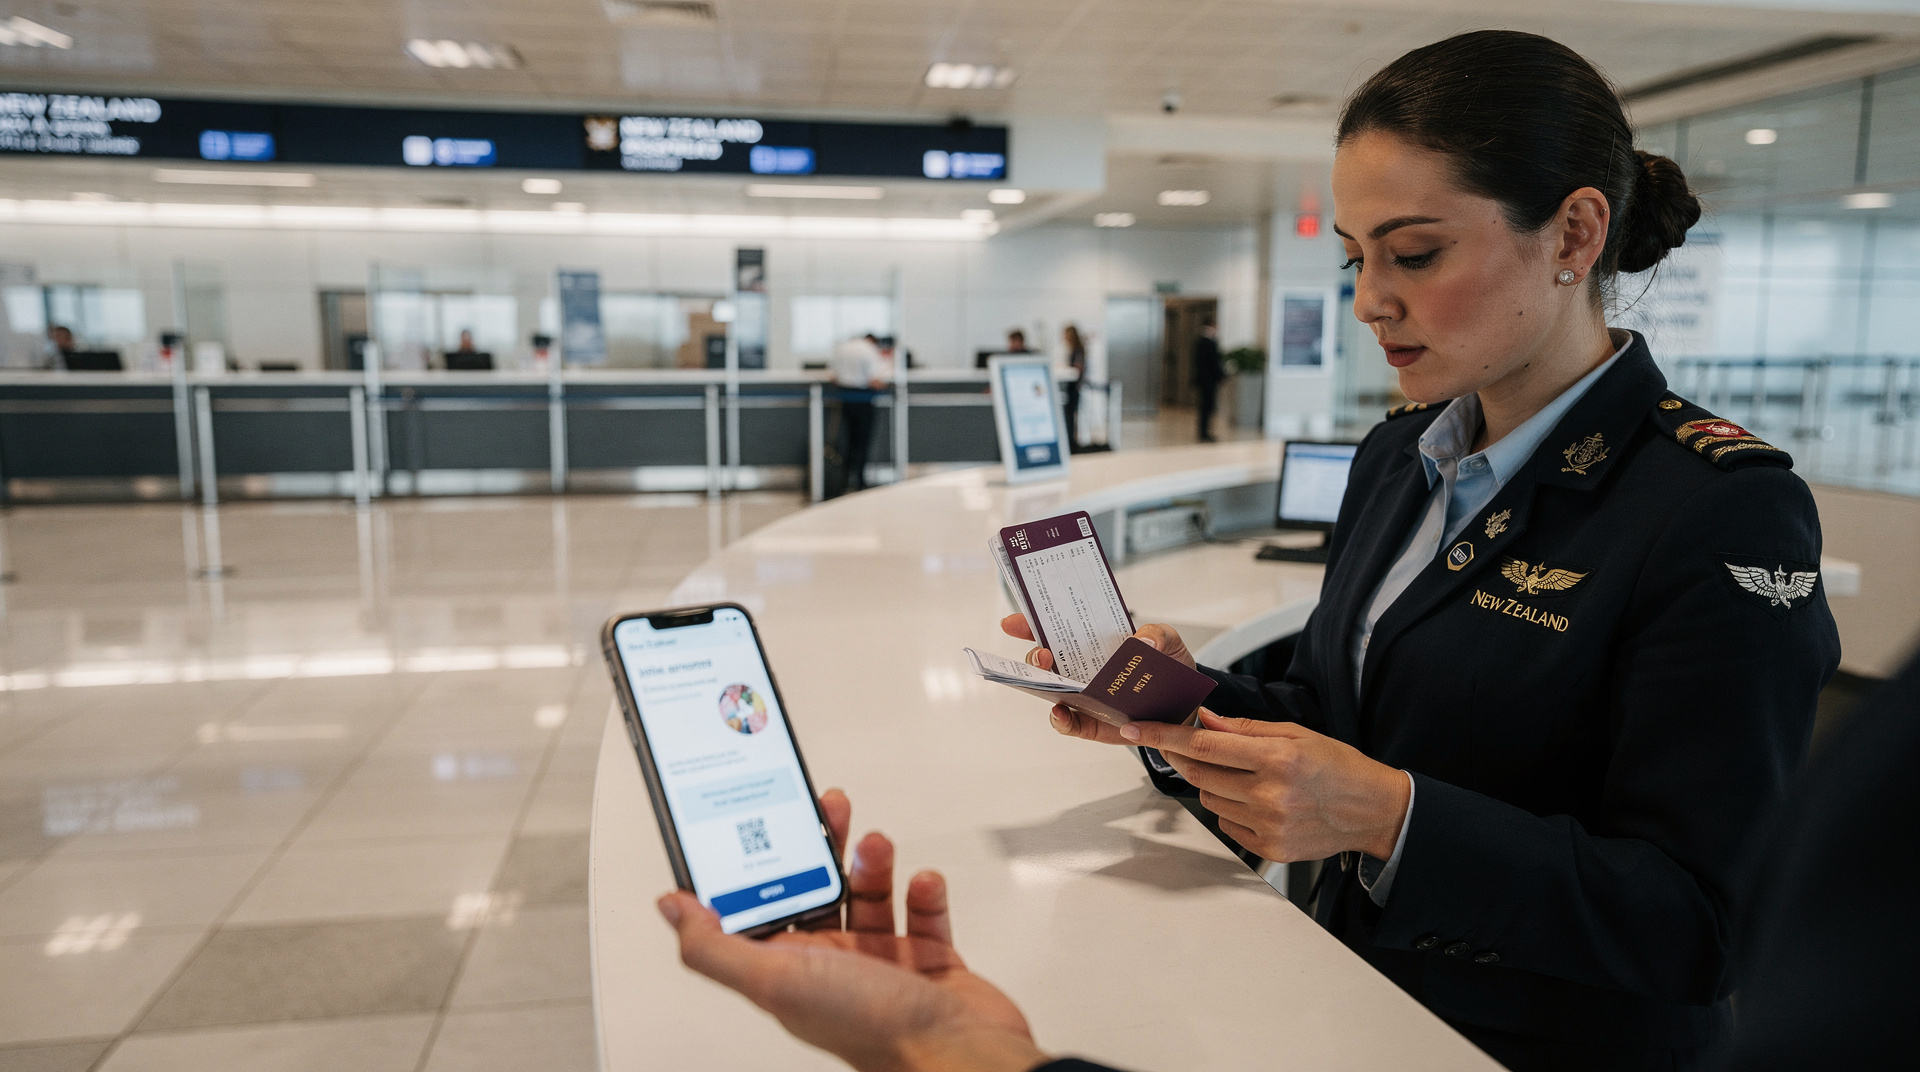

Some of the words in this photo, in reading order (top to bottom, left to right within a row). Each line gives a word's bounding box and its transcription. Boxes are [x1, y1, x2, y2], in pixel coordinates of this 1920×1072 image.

[48, 94, 161, 123] ZEALAND
[620, 117, 668, 138] NEW
[667, 117, 763, 143] ZEALAND
[1470, 589, 1505, 611] NEW
[1502, 598, 1569, 632] ZEALAND
